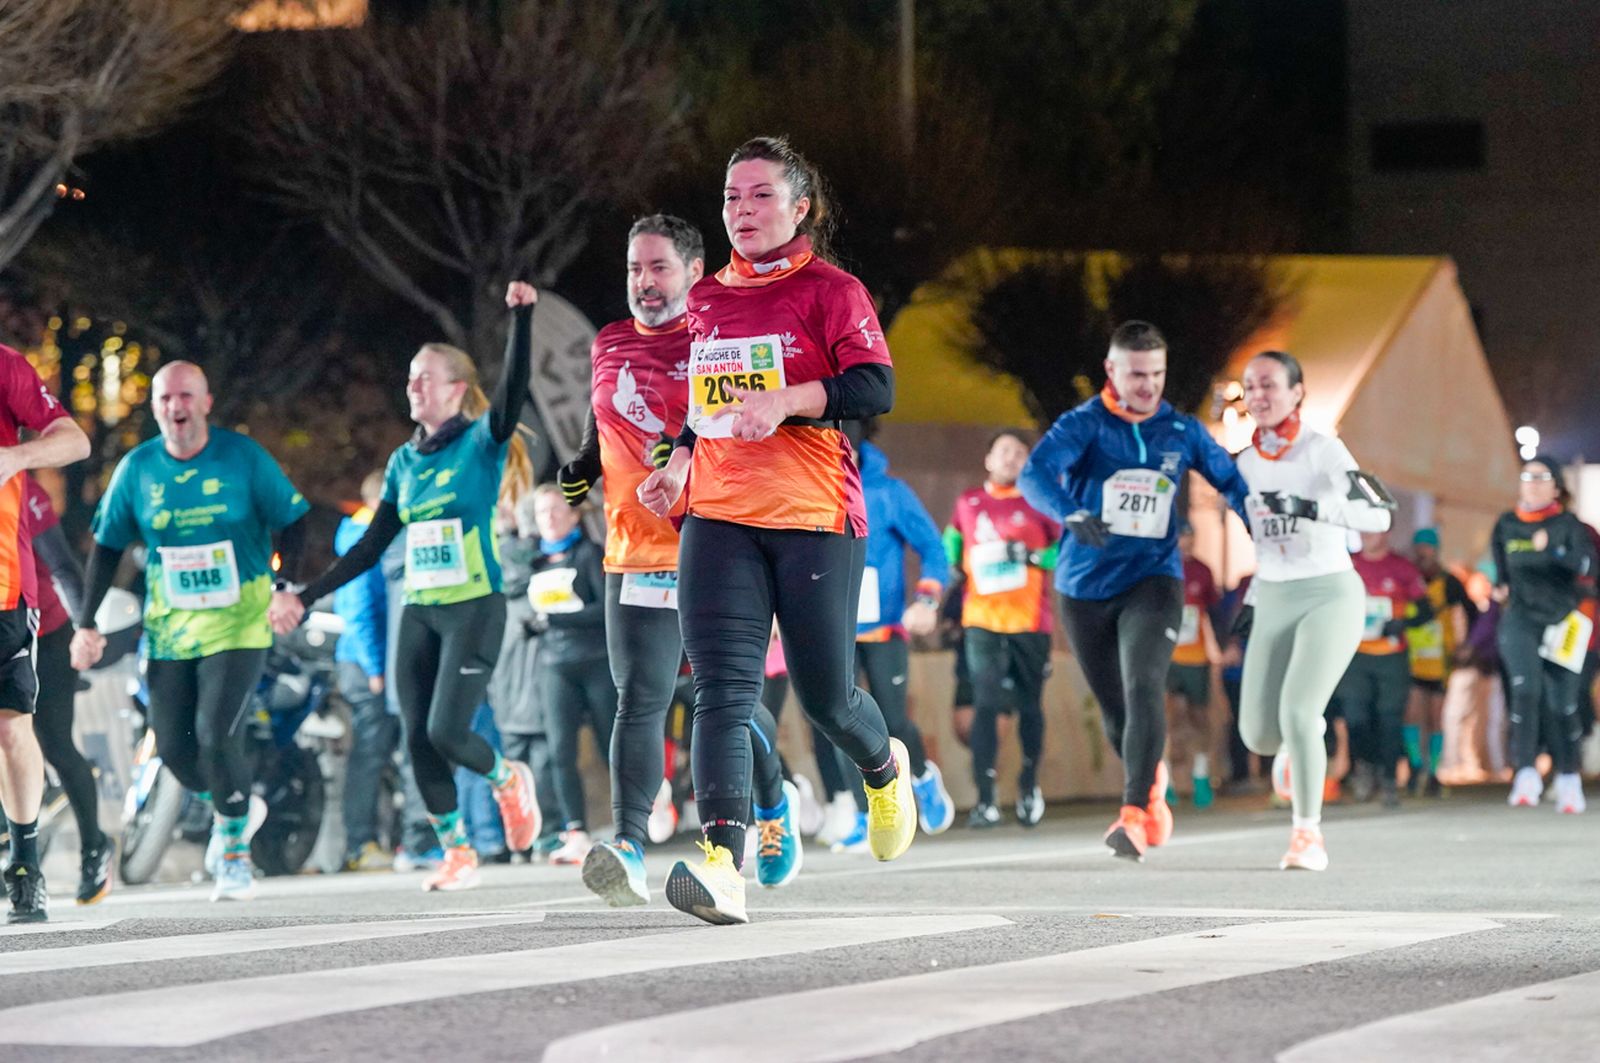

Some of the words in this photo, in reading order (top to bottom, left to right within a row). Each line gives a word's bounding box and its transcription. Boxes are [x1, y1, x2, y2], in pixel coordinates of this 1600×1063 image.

[730, 350, 742, 360] DE
[696, 364, 712, 375] SAN
[627, 400, 646, 422] 43
[1119, 492, 1158, 514] 2871
[180, 568, 222, 589] 6148
